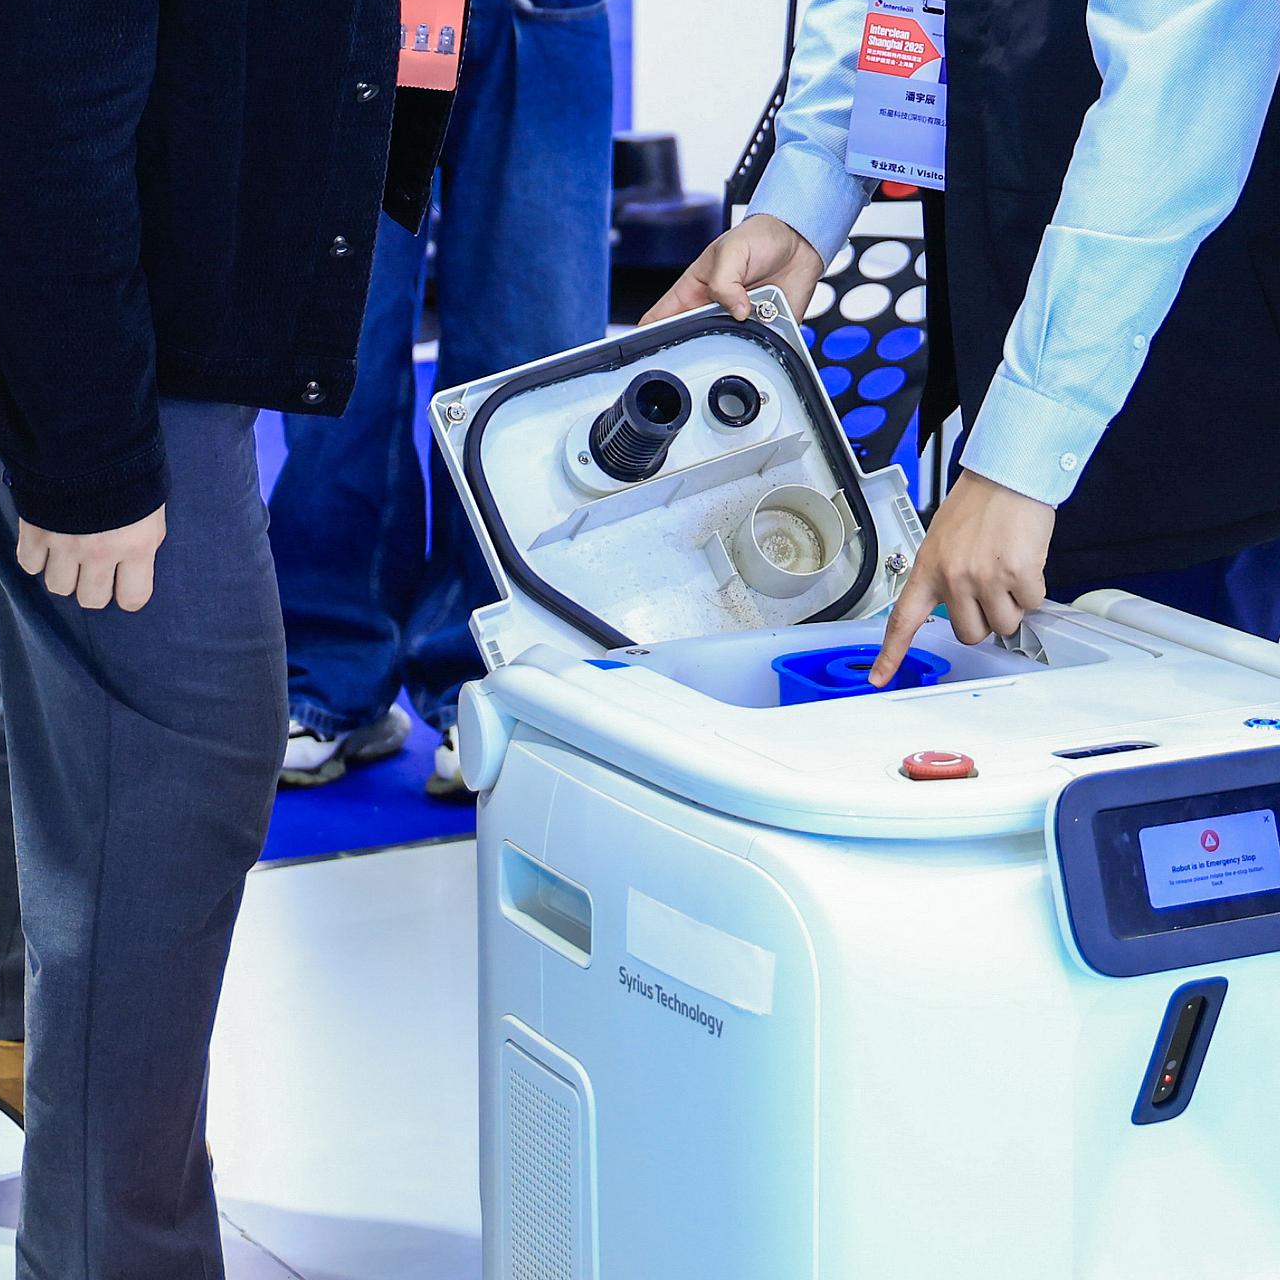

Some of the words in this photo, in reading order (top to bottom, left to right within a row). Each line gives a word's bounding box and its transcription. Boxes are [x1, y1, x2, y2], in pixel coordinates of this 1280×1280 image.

[883, 2, 914, 13] Interclean
[869, 24, 910, 40] Interclean
[867, 35, 903, 51] Shanghai
[903, 41, 925, 54] 2025
[905, 90, 937, 105] 潘宇辰
[870, 159, 906, 174] 专业观众
[1171, 863, 1191, 873] Robot
[1206, 856, 1240, 869] Emergency
[1241, 853, 1257, 863] Stop
[618, 965, 654, 1000] Syrius
[654, 983, 724, 1038] Technology
